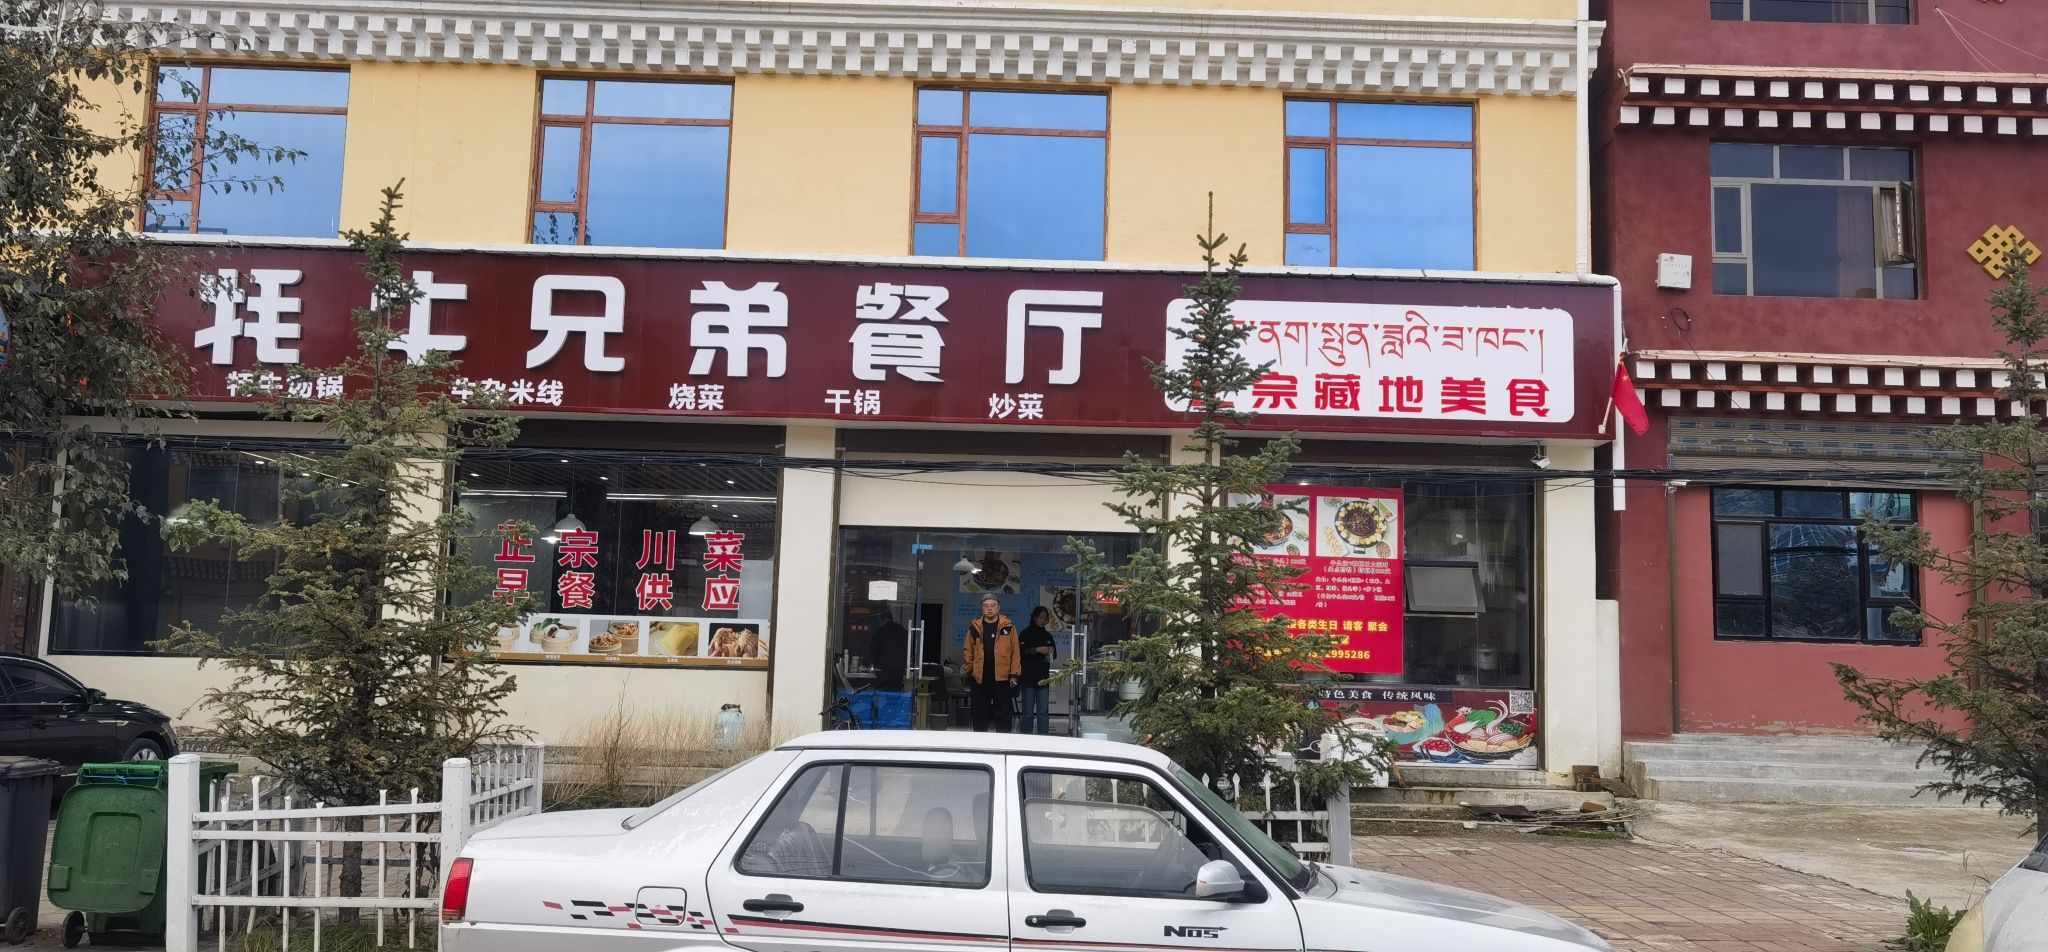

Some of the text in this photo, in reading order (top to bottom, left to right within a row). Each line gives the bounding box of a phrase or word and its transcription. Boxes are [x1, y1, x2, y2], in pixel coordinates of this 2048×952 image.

[194, 268, 1104, 385] 牦牛兄弟餐厅
[226, 371, 1044, 419] 牦牛汤锅 牛杂米线 烧菜 干锅 炒菜
[494, 523, 745, 572] 正宗川菜
[493, 568, 741, 611] 早餐供应
[1343, 620, 1363, 632] 请客
[1367, 621, 1388, 632] 聚会
[1319, 690, 1437, 701] 特色美食 传统风味
